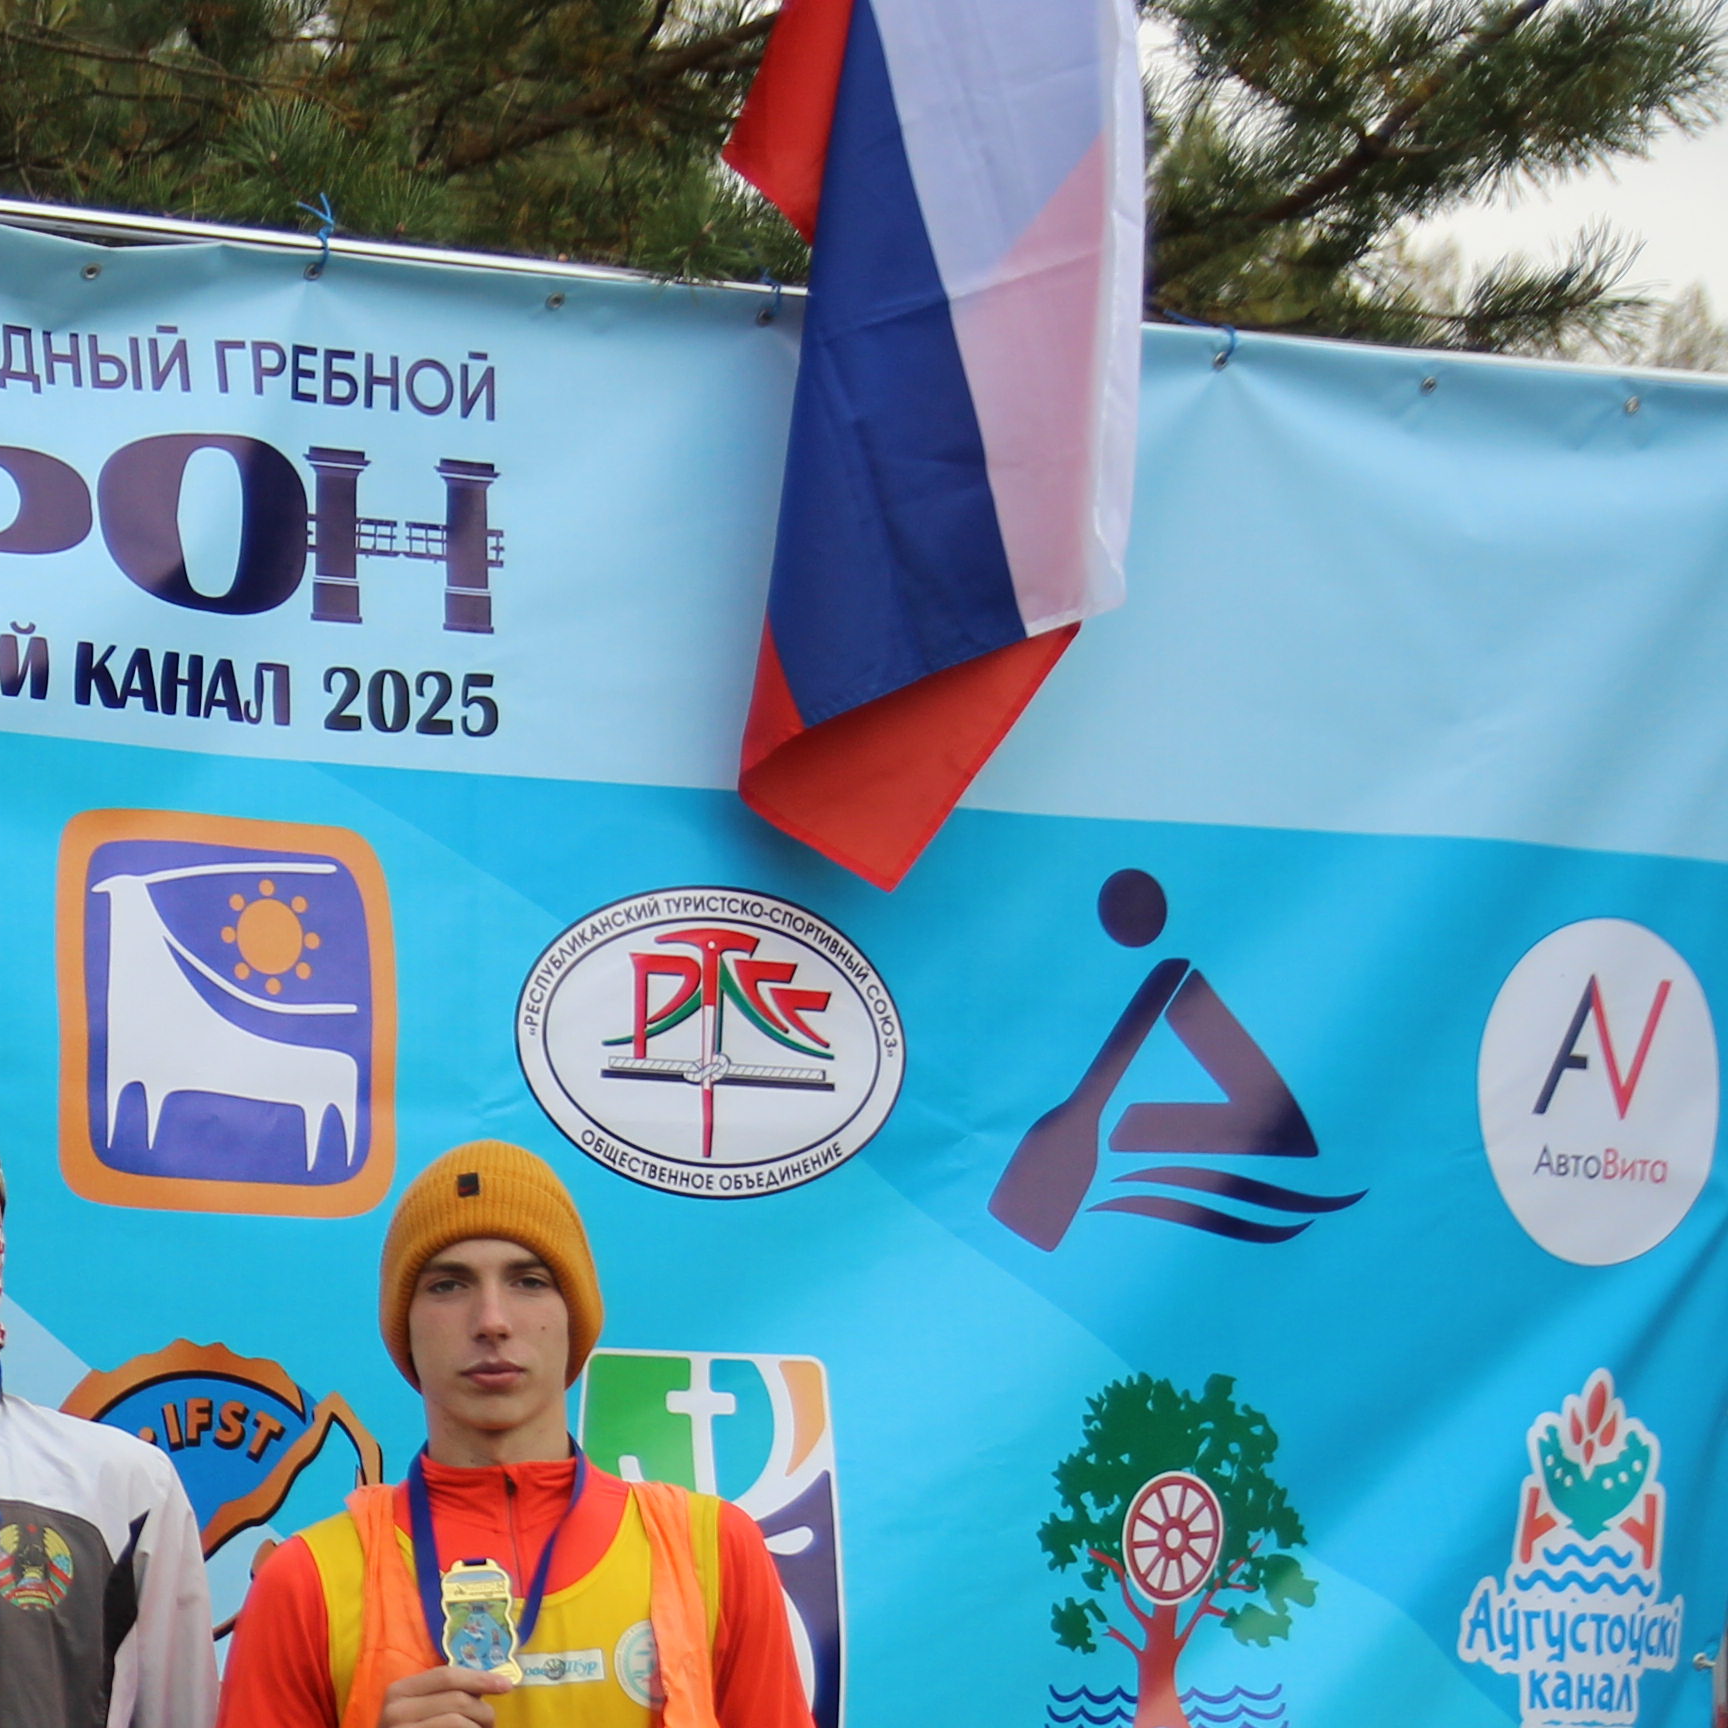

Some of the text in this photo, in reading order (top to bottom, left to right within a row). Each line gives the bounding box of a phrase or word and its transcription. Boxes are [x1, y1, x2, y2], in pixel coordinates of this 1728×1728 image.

[214, 342, 499, 422] ГРЕБНОЙ
[74, 641, 288, 728] КАНАЛ
[322, 667, 500, 737] 2025
[664, 896, 870, 984] ТУРИСТСКО-СПОРТИВНЫЙ
[581, 1128, 843, 1191] ОБЩЕСТВЕННОЕ ОБЪЕДИНЕНИЕ
[1533, 1143, 1669, 1184] АвтоВита
[162, 1398, 285, 1463] IFST
[1528, 1670, 1633, 1713] канал
